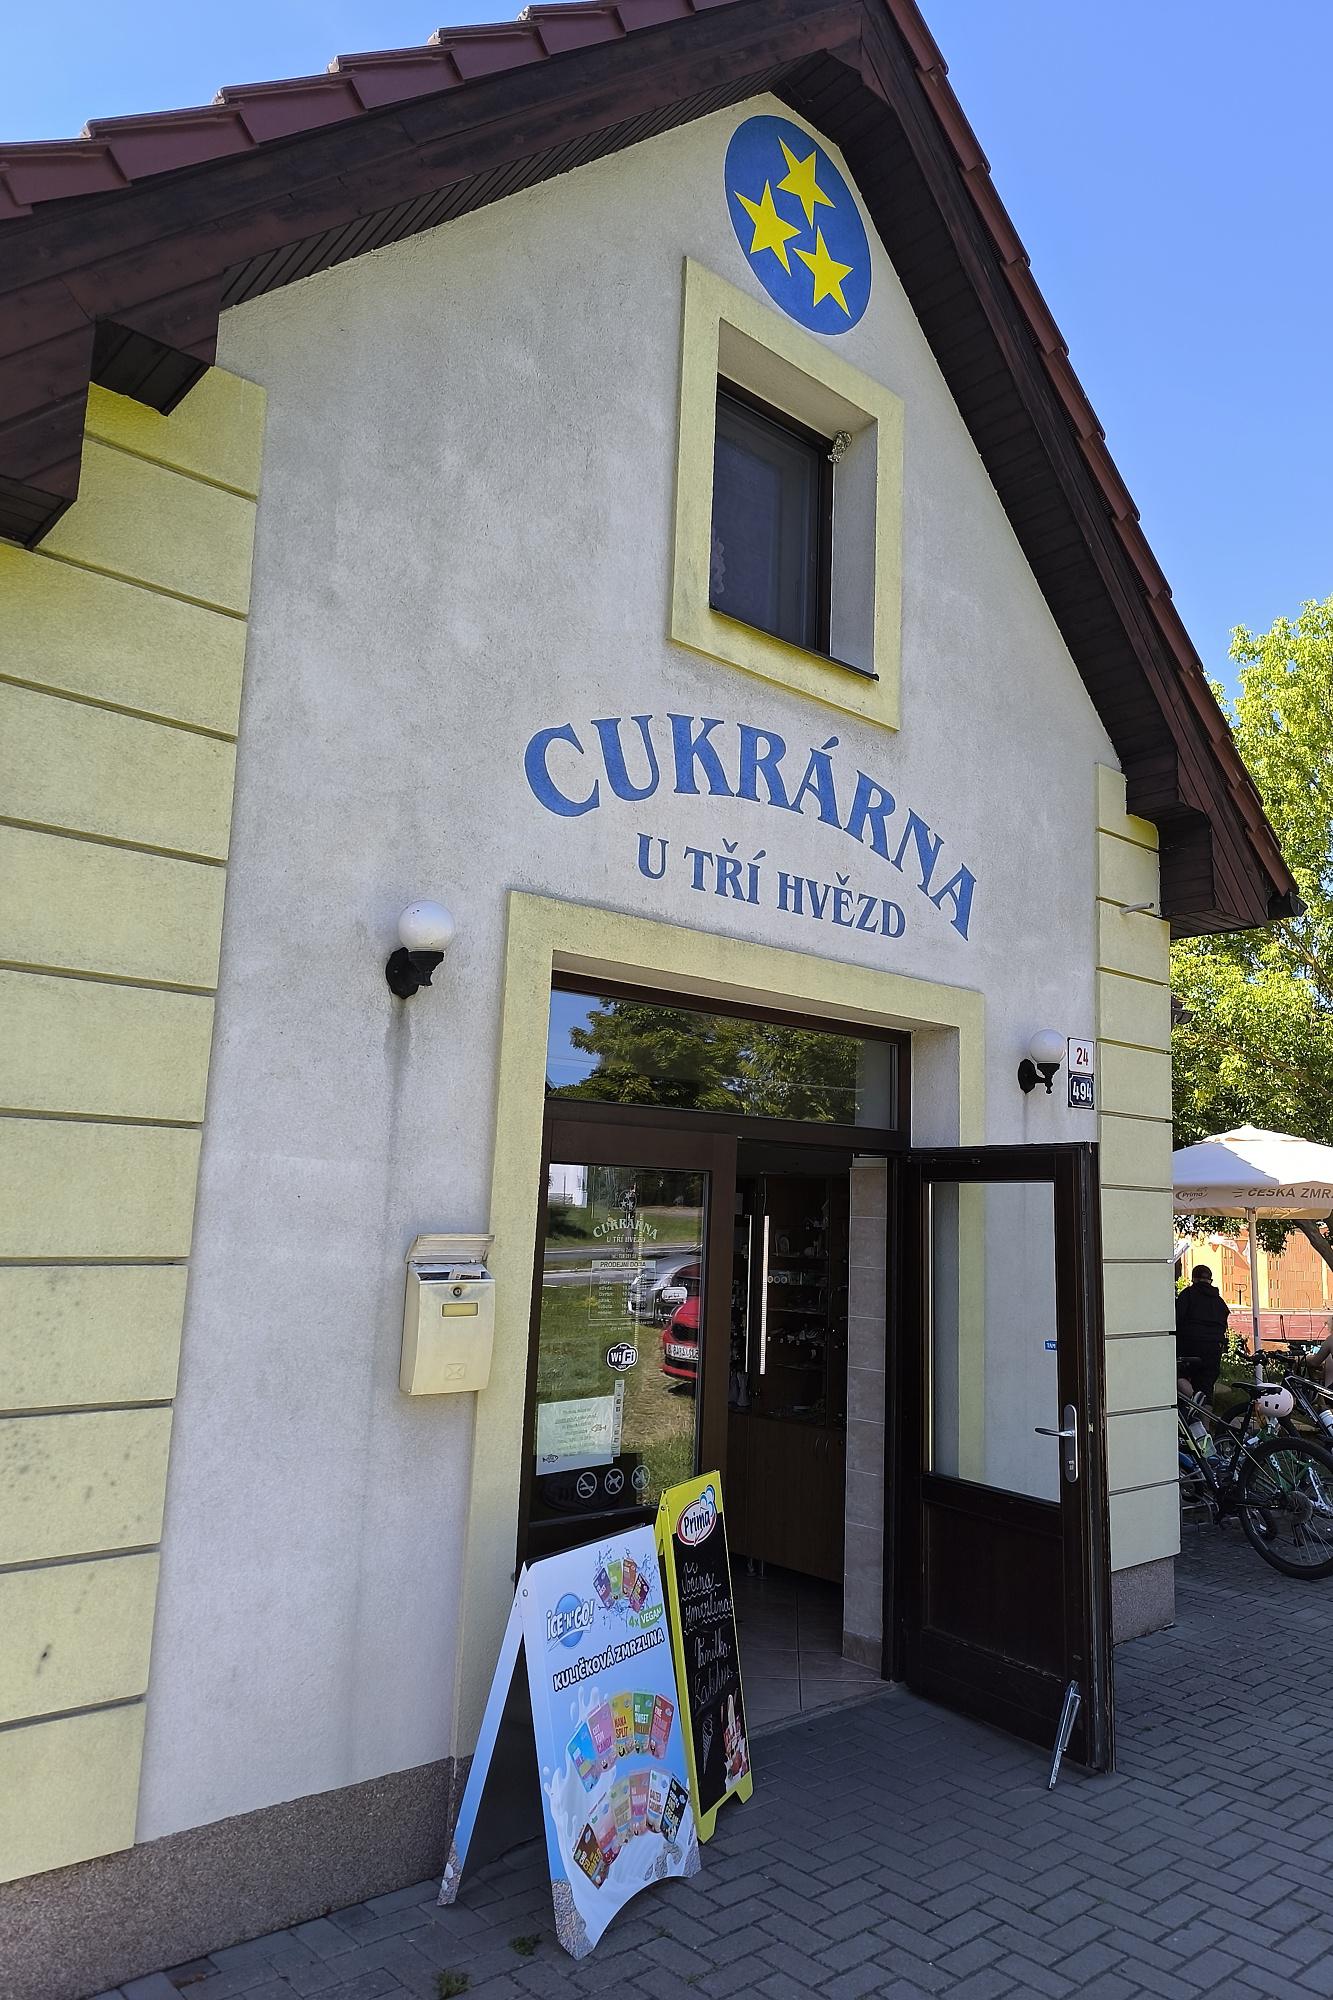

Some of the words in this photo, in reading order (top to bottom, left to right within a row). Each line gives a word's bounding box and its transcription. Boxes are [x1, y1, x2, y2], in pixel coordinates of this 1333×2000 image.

[524, 713, 977, 941] CUKRÁRNA
[637, 833, 669, 880] U
[683, 838, 766, 905] TŘÍ
[776, 871, 906, 939] HVĚZD
[1076, 1047, 1089, 1066] 24
[1072, 1081, 1092, 1102] 494
[1301, 1188, 1333, 1199] ZMR
[593, 1216, 658, 1240] CUKRÁRNA
[684, 1510, 711, 1537] Prima
[640, 1607, 662, 1625] VEGAN
[553, 1645, 616, 1692] KULIČKOVÁ
[614, 1628, 665, 1664] ZMRZLINA
